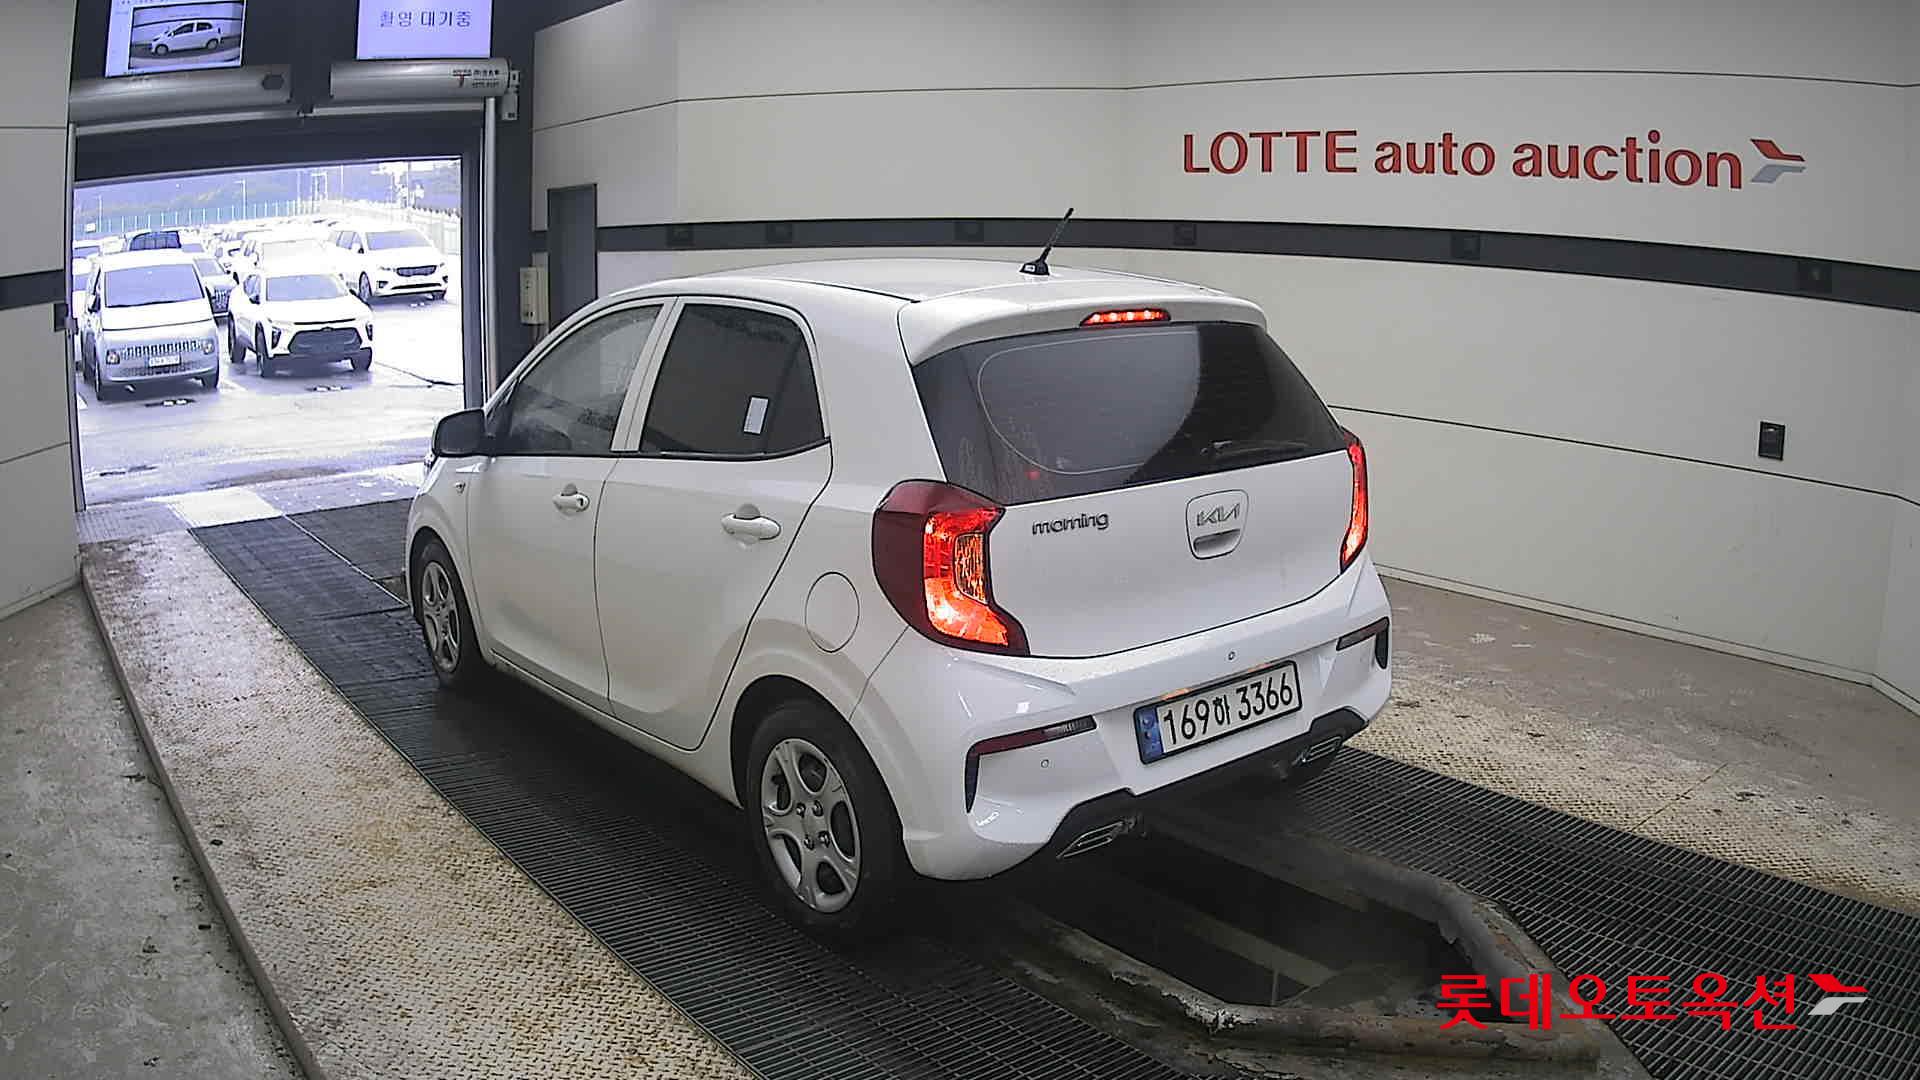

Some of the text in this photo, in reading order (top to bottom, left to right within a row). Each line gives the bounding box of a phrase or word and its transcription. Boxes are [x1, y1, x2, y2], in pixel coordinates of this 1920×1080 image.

[421, 11, 471, 27] 대기중
[1184, 130, 1743, 190] LOTTE auto auction
[1031, 512, 1109, 536] morning
[1163, 694, 1231, 745] 169하
[1235, 673, 1293, 720] 3366
